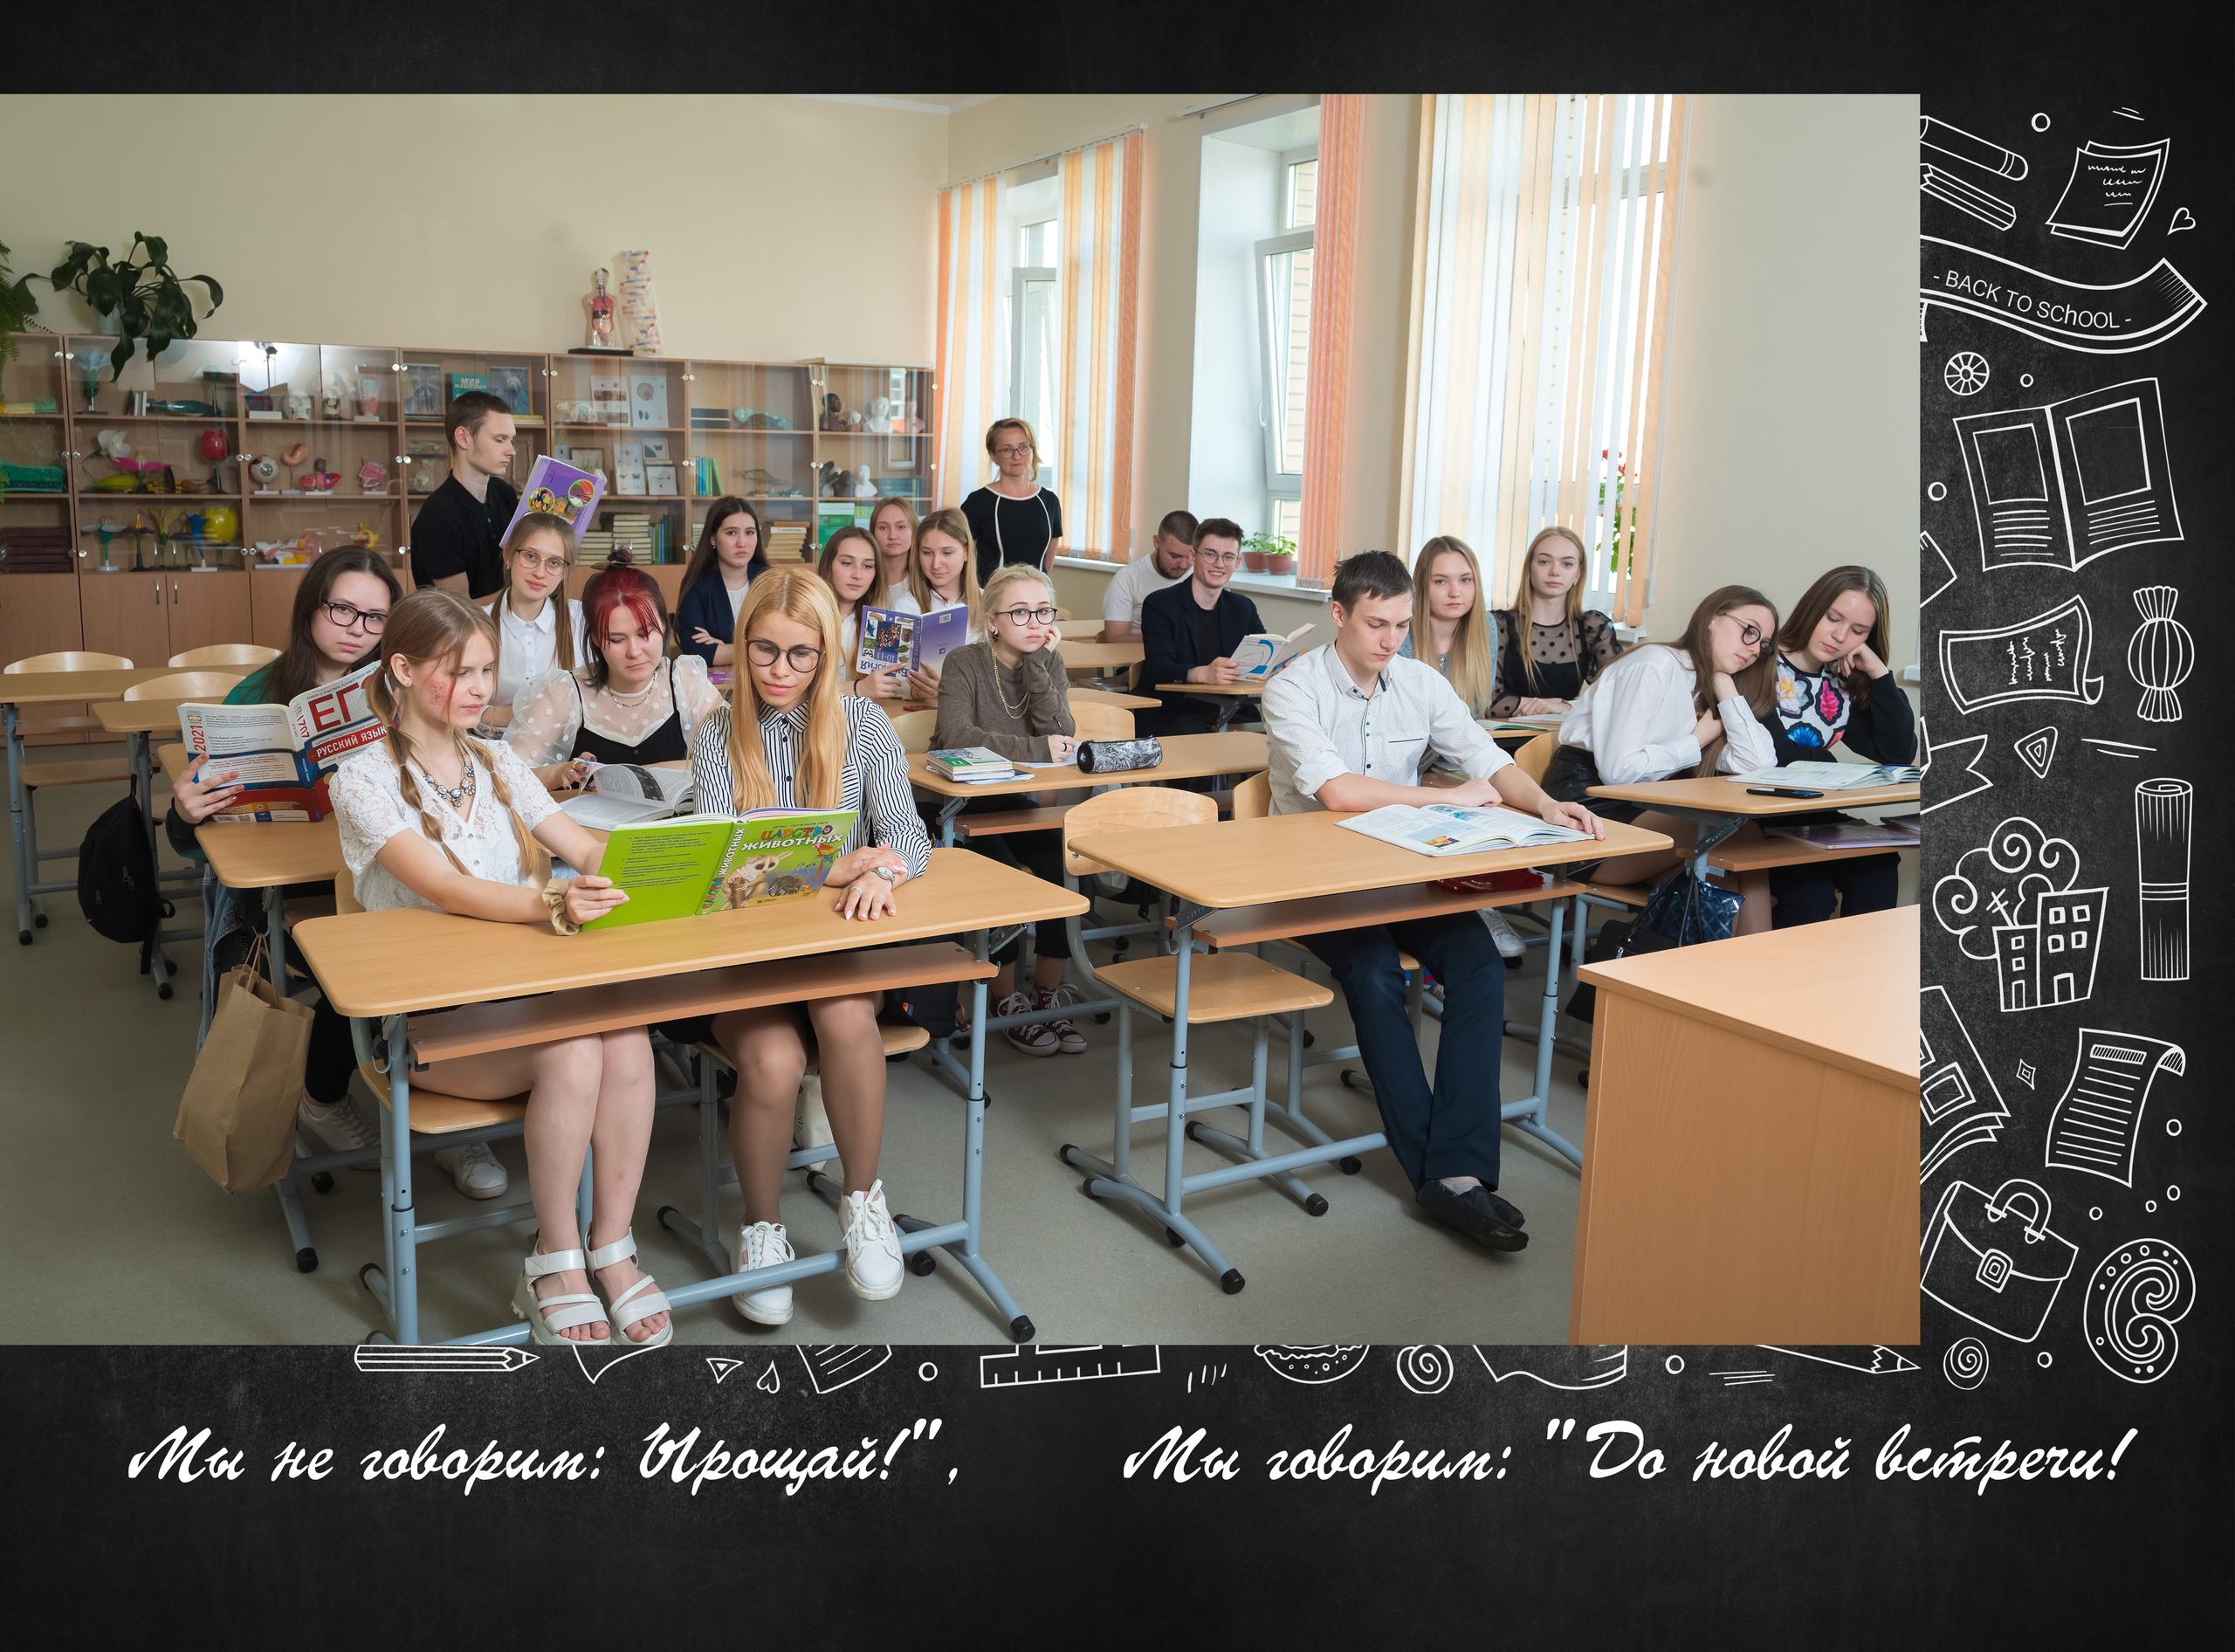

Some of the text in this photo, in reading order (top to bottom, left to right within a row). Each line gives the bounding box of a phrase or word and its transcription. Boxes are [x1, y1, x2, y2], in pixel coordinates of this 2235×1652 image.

[190, 725, 207, 752] 2021
[316, 726, 387, 758] РУССКИЙ ЯЗЫК
[740, 833, 844, 851] ЖИВОТНЫХ
[761, 824, 834, 841] ЦАРСТВО
[719, 828, 746, 876] ЖИВОТНЫХ
